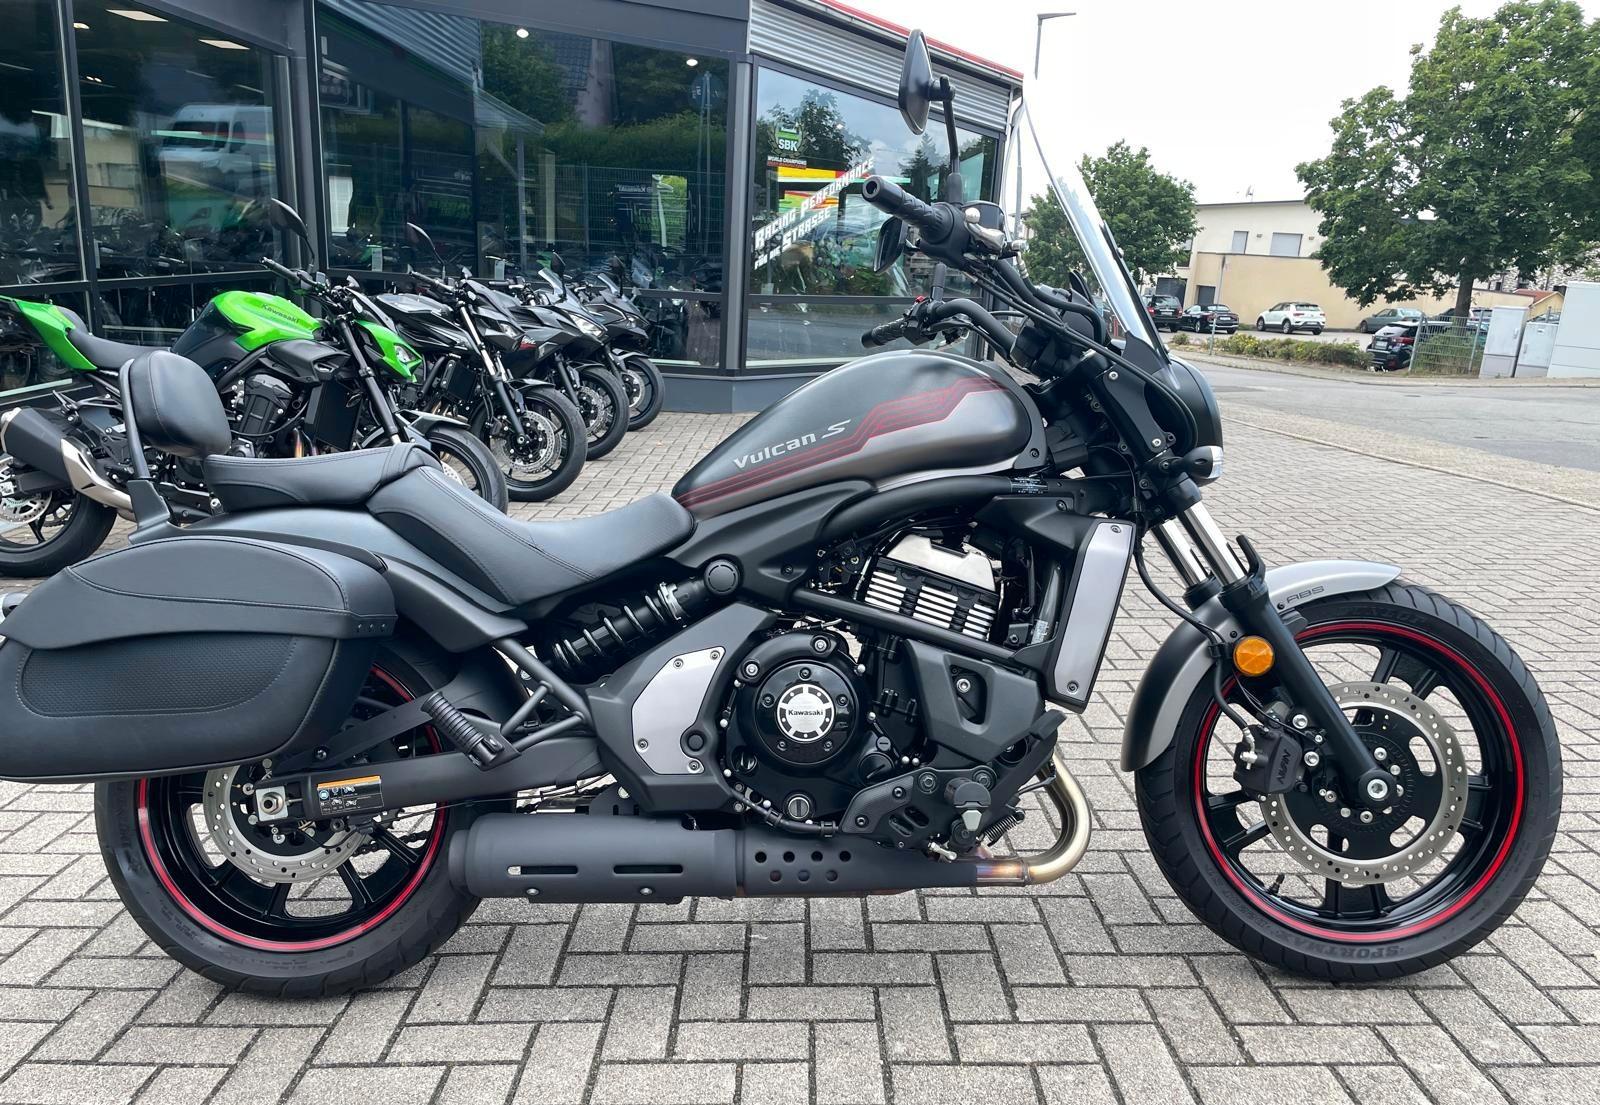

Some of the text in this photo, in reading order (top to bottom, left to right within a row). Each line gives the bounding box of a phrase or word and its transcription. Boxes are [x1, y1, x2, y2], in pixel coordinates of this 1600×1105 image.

[778, 138, 798, 151] SBK
[754, 157, 875, 251] RACING PERFORMANCE
[781, 206, 831, 251] STRASSE
[733, 418, 851, 469] Vulcan S
[1286, 585, 1325, 603] ABS
